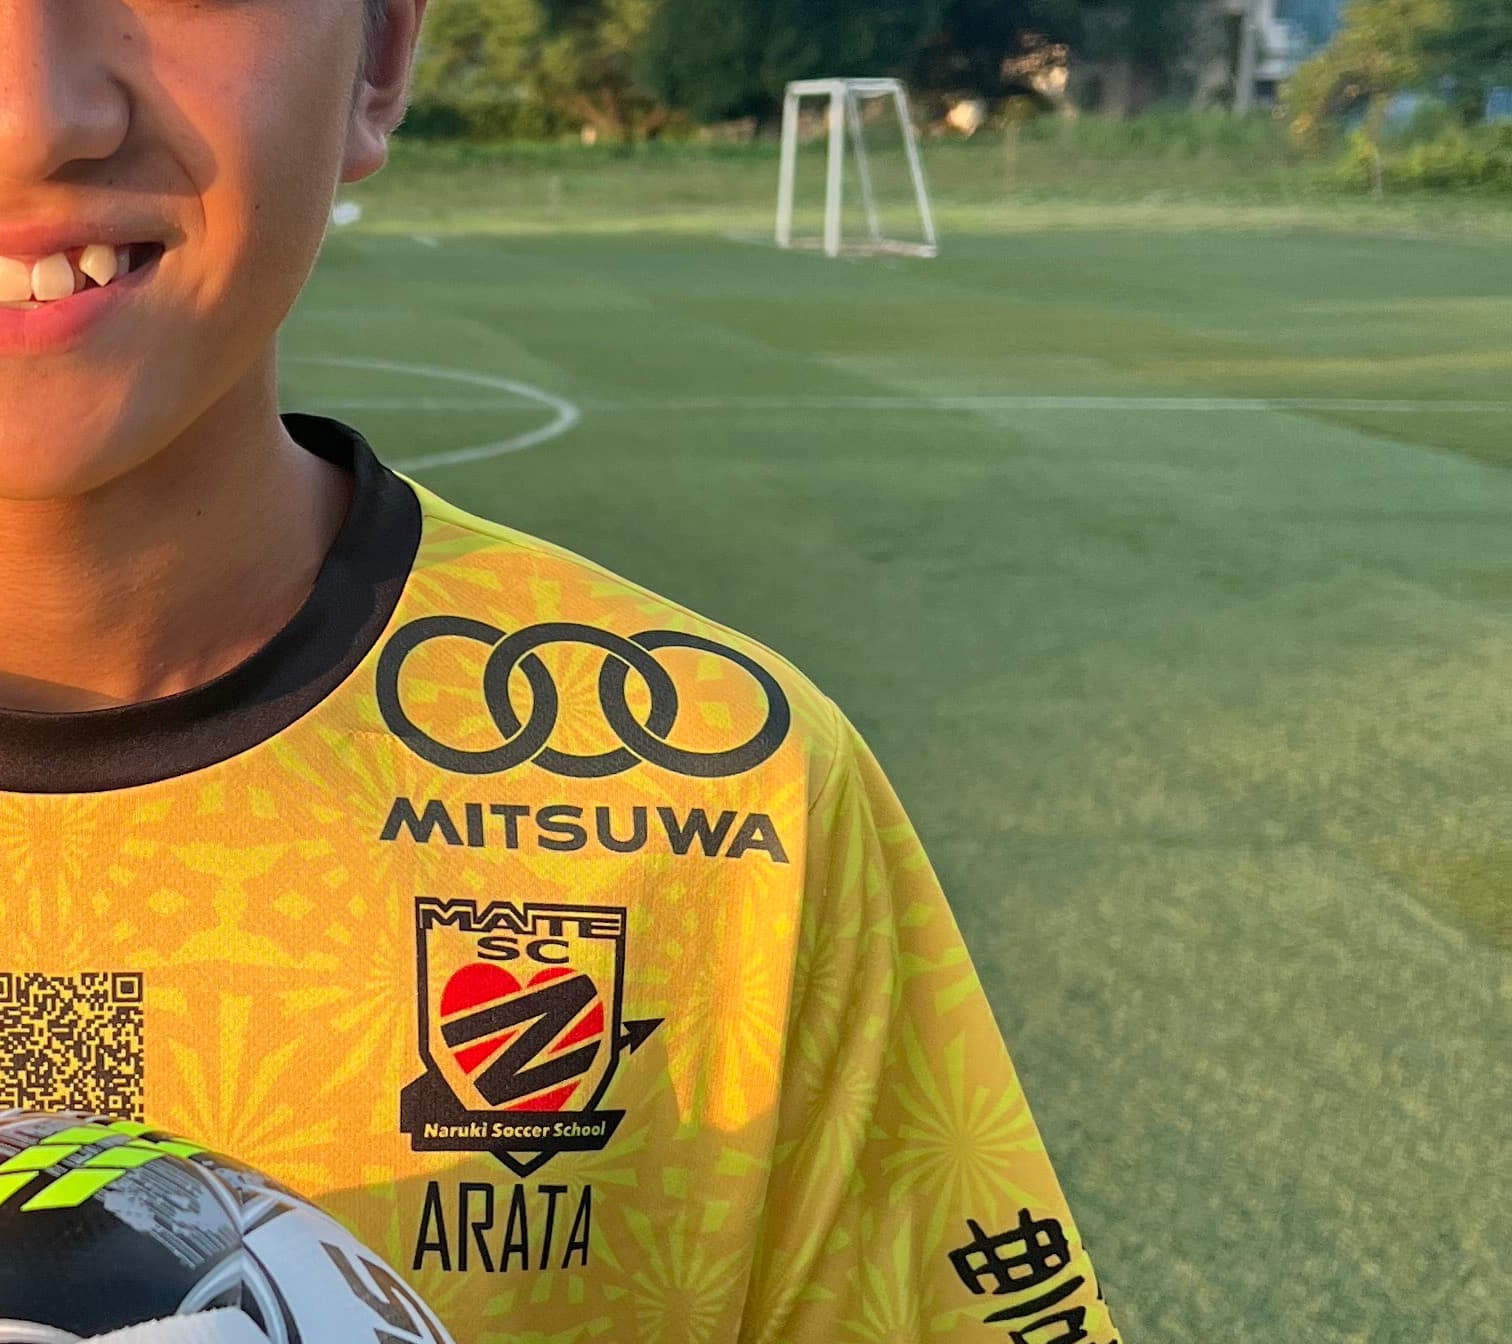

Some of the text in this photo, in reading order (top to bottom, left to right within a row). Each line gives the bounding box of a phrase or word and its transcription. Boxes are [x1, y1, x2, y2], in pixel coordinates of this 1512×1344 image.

[380, 796, 790, 864] MITSUWA
[418, 902, 624, 940] MATE
[477, 936, 570, 964] SC
[424, 1120, 607, 1138] Naruki Soccer School
[413, 1182, 592, 1274] ARATA
